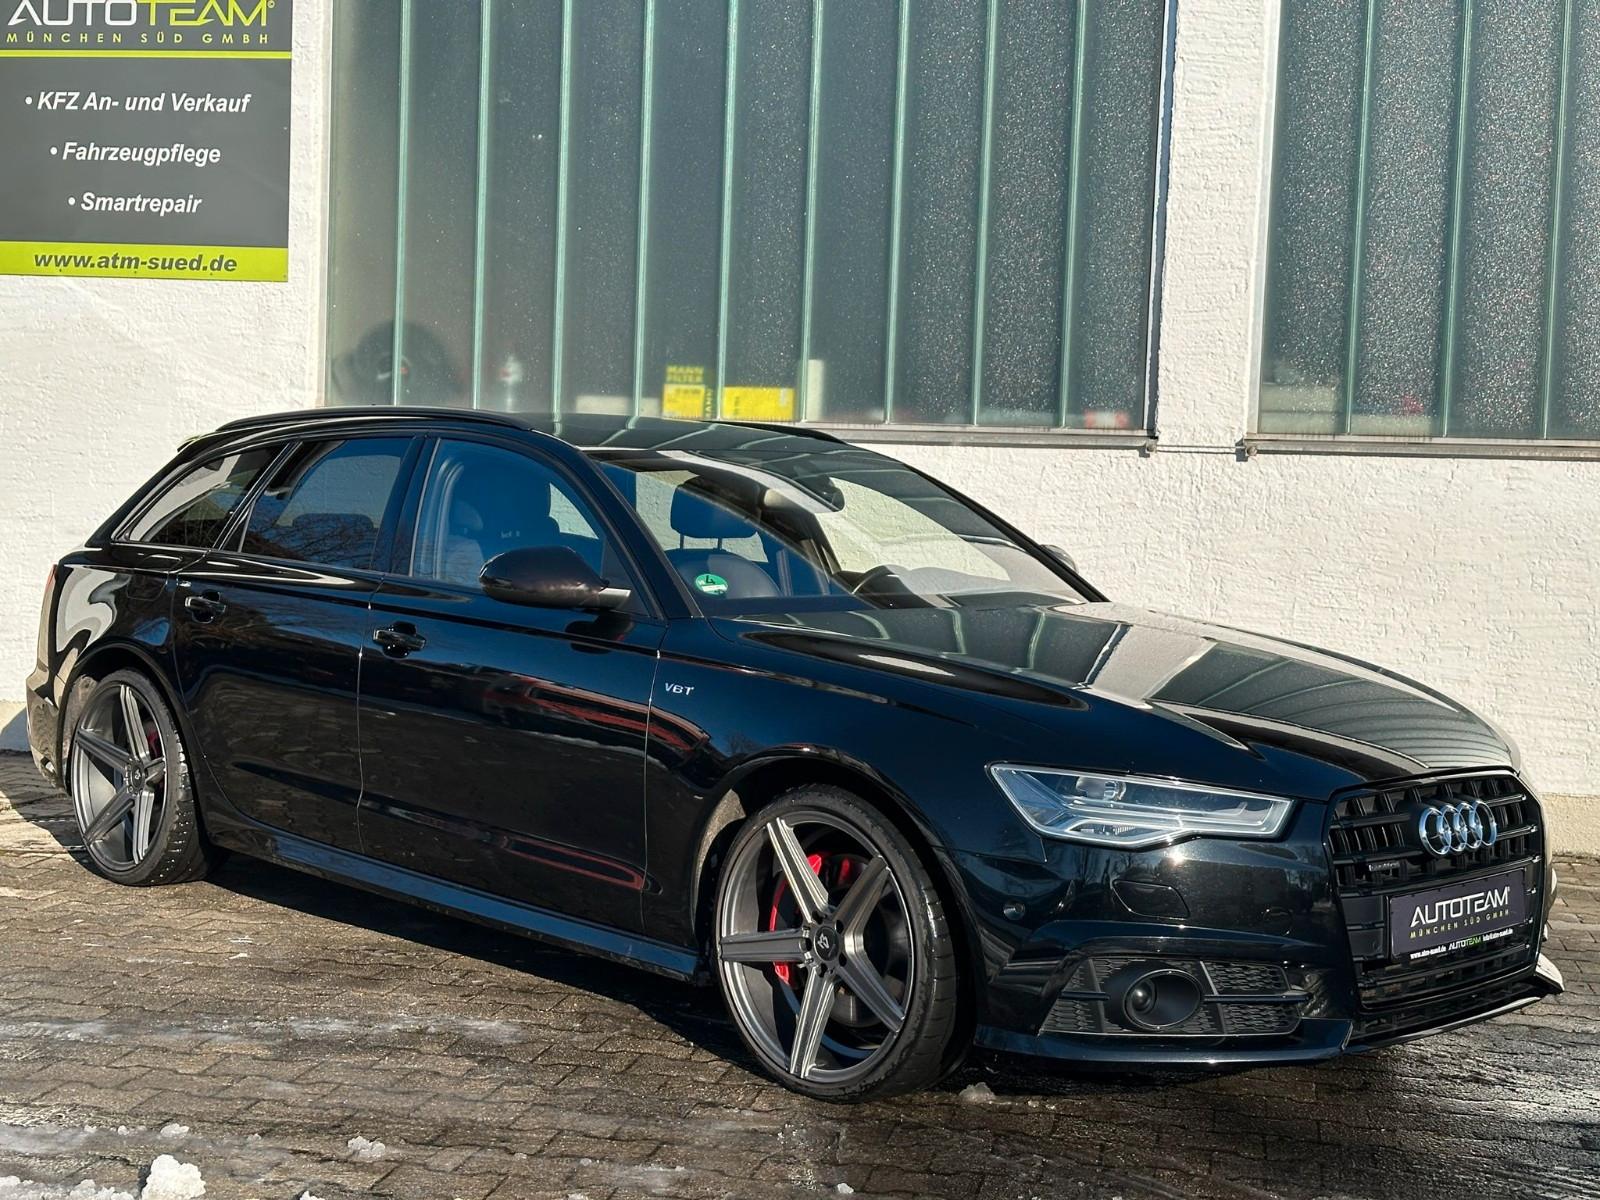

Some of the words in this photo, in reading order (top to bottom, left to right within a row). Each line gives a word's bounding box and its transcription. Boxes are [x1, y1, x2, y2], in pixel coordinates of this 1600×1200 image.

[6, 31, 122, 43] MÜNCHEN
[140, 31, 183, 43] SÜD
[201, 33, 268, 44] GMBH
[37, 91, 80, 110] KFZ
[83, 92, 119, 111] An-
[125, 93, 164, 112] und
[171, 93, 252, 113] Verkauf
[62, 142, 221, 167] Fahrzeugpflege
[80, 192, 202, 216] Smartrepair
[34, 252, 238, 272] www.atm-sued.de
[1410, 922, 1458, 939] MÜNCHEN
[1464, 916, 1481, 927] SÜD
